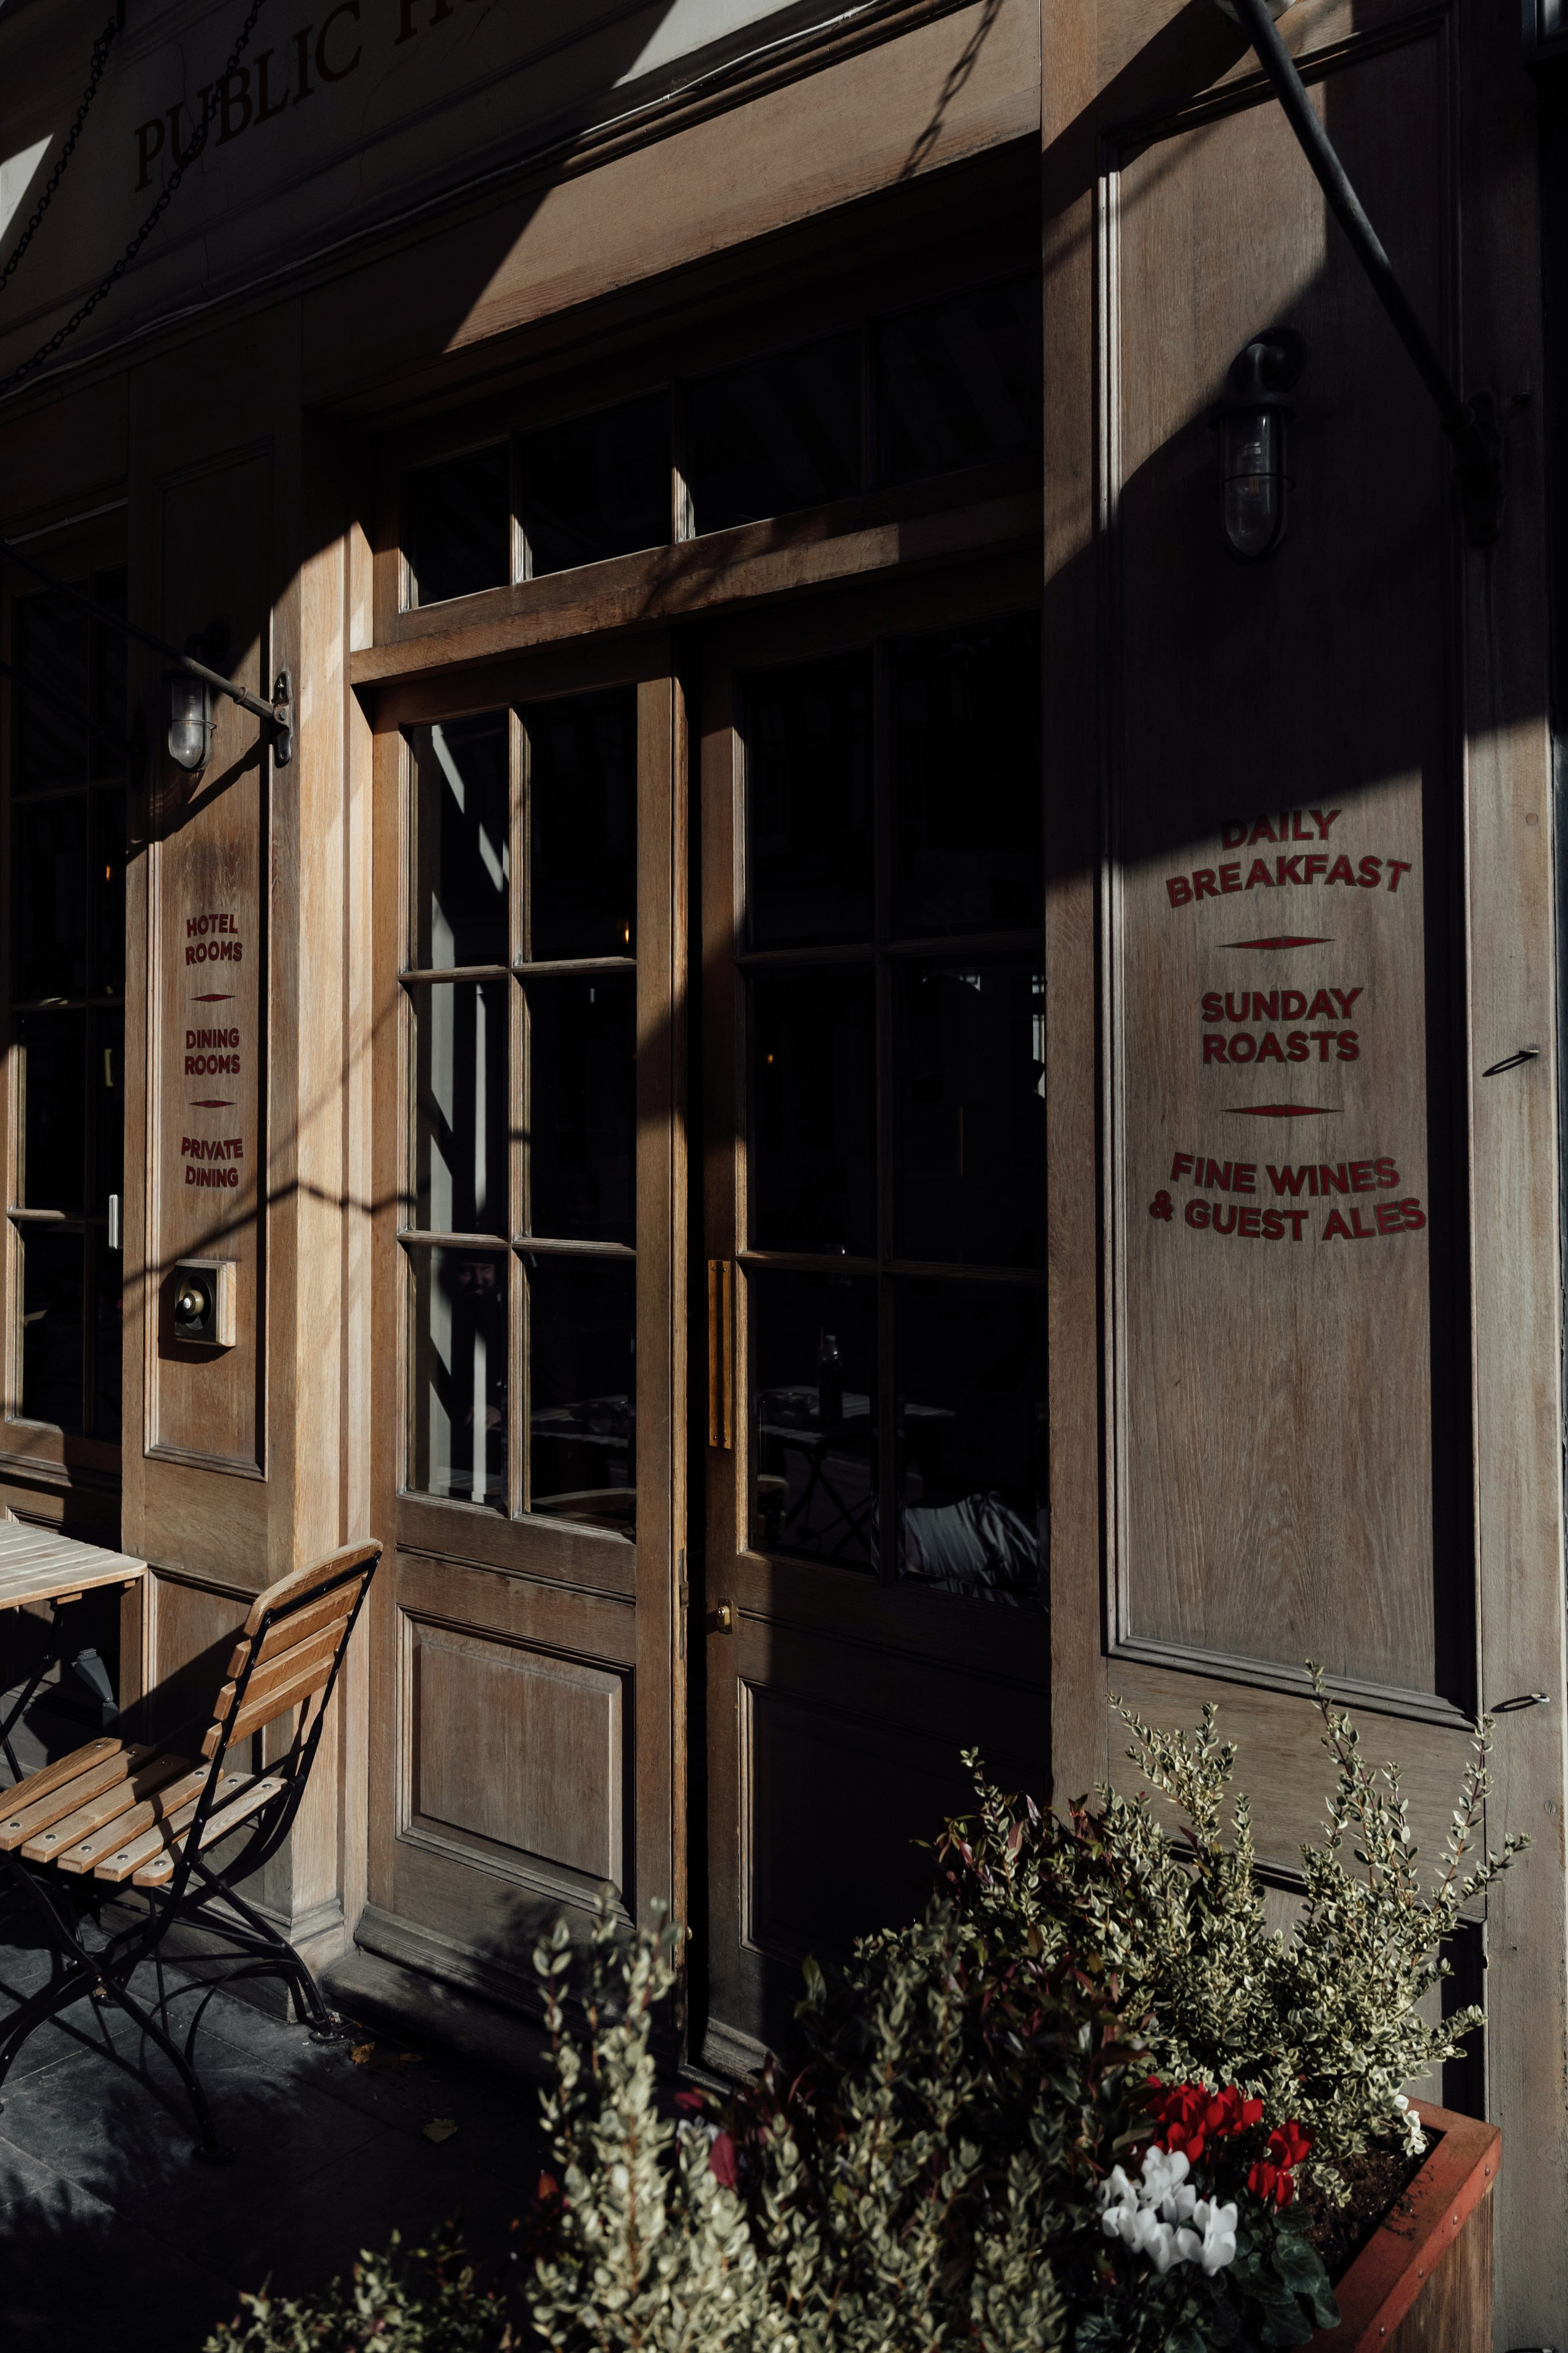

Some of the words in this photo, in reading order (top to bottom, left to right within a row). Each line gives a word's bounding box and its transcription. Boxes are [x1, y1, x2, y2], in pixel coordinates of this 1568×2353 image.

[134, 0, 363, 192] PUBLIC
[1221, 809, 1341, 850] DAILY
[1166, 854, 1412, 908] BREAKFAST
[186, 913, 238, 938] HOTEL
[186, 941, 243, 965] ROOMS
[1201, 988, 1364, 1022] SUNDAY
[186, 1028, 239, 1049] DINING
[1203, 1030, 1359, 1063] ROASTS
[185, 1054, 240, 1075] ROOMS
[181, 1136, 244, 1160] PRIVATE
[185, 1165, 238, 1187] DINING
[1170, 1152, 1256, 1194] FINE
[1266, 1157, 1400, 1196] WINES
[1149, 1190, 1174, 1222] &
[1185, 1199, 1308, 1241] GUEST
[1322, 1198, 1427, 1241] ALES
